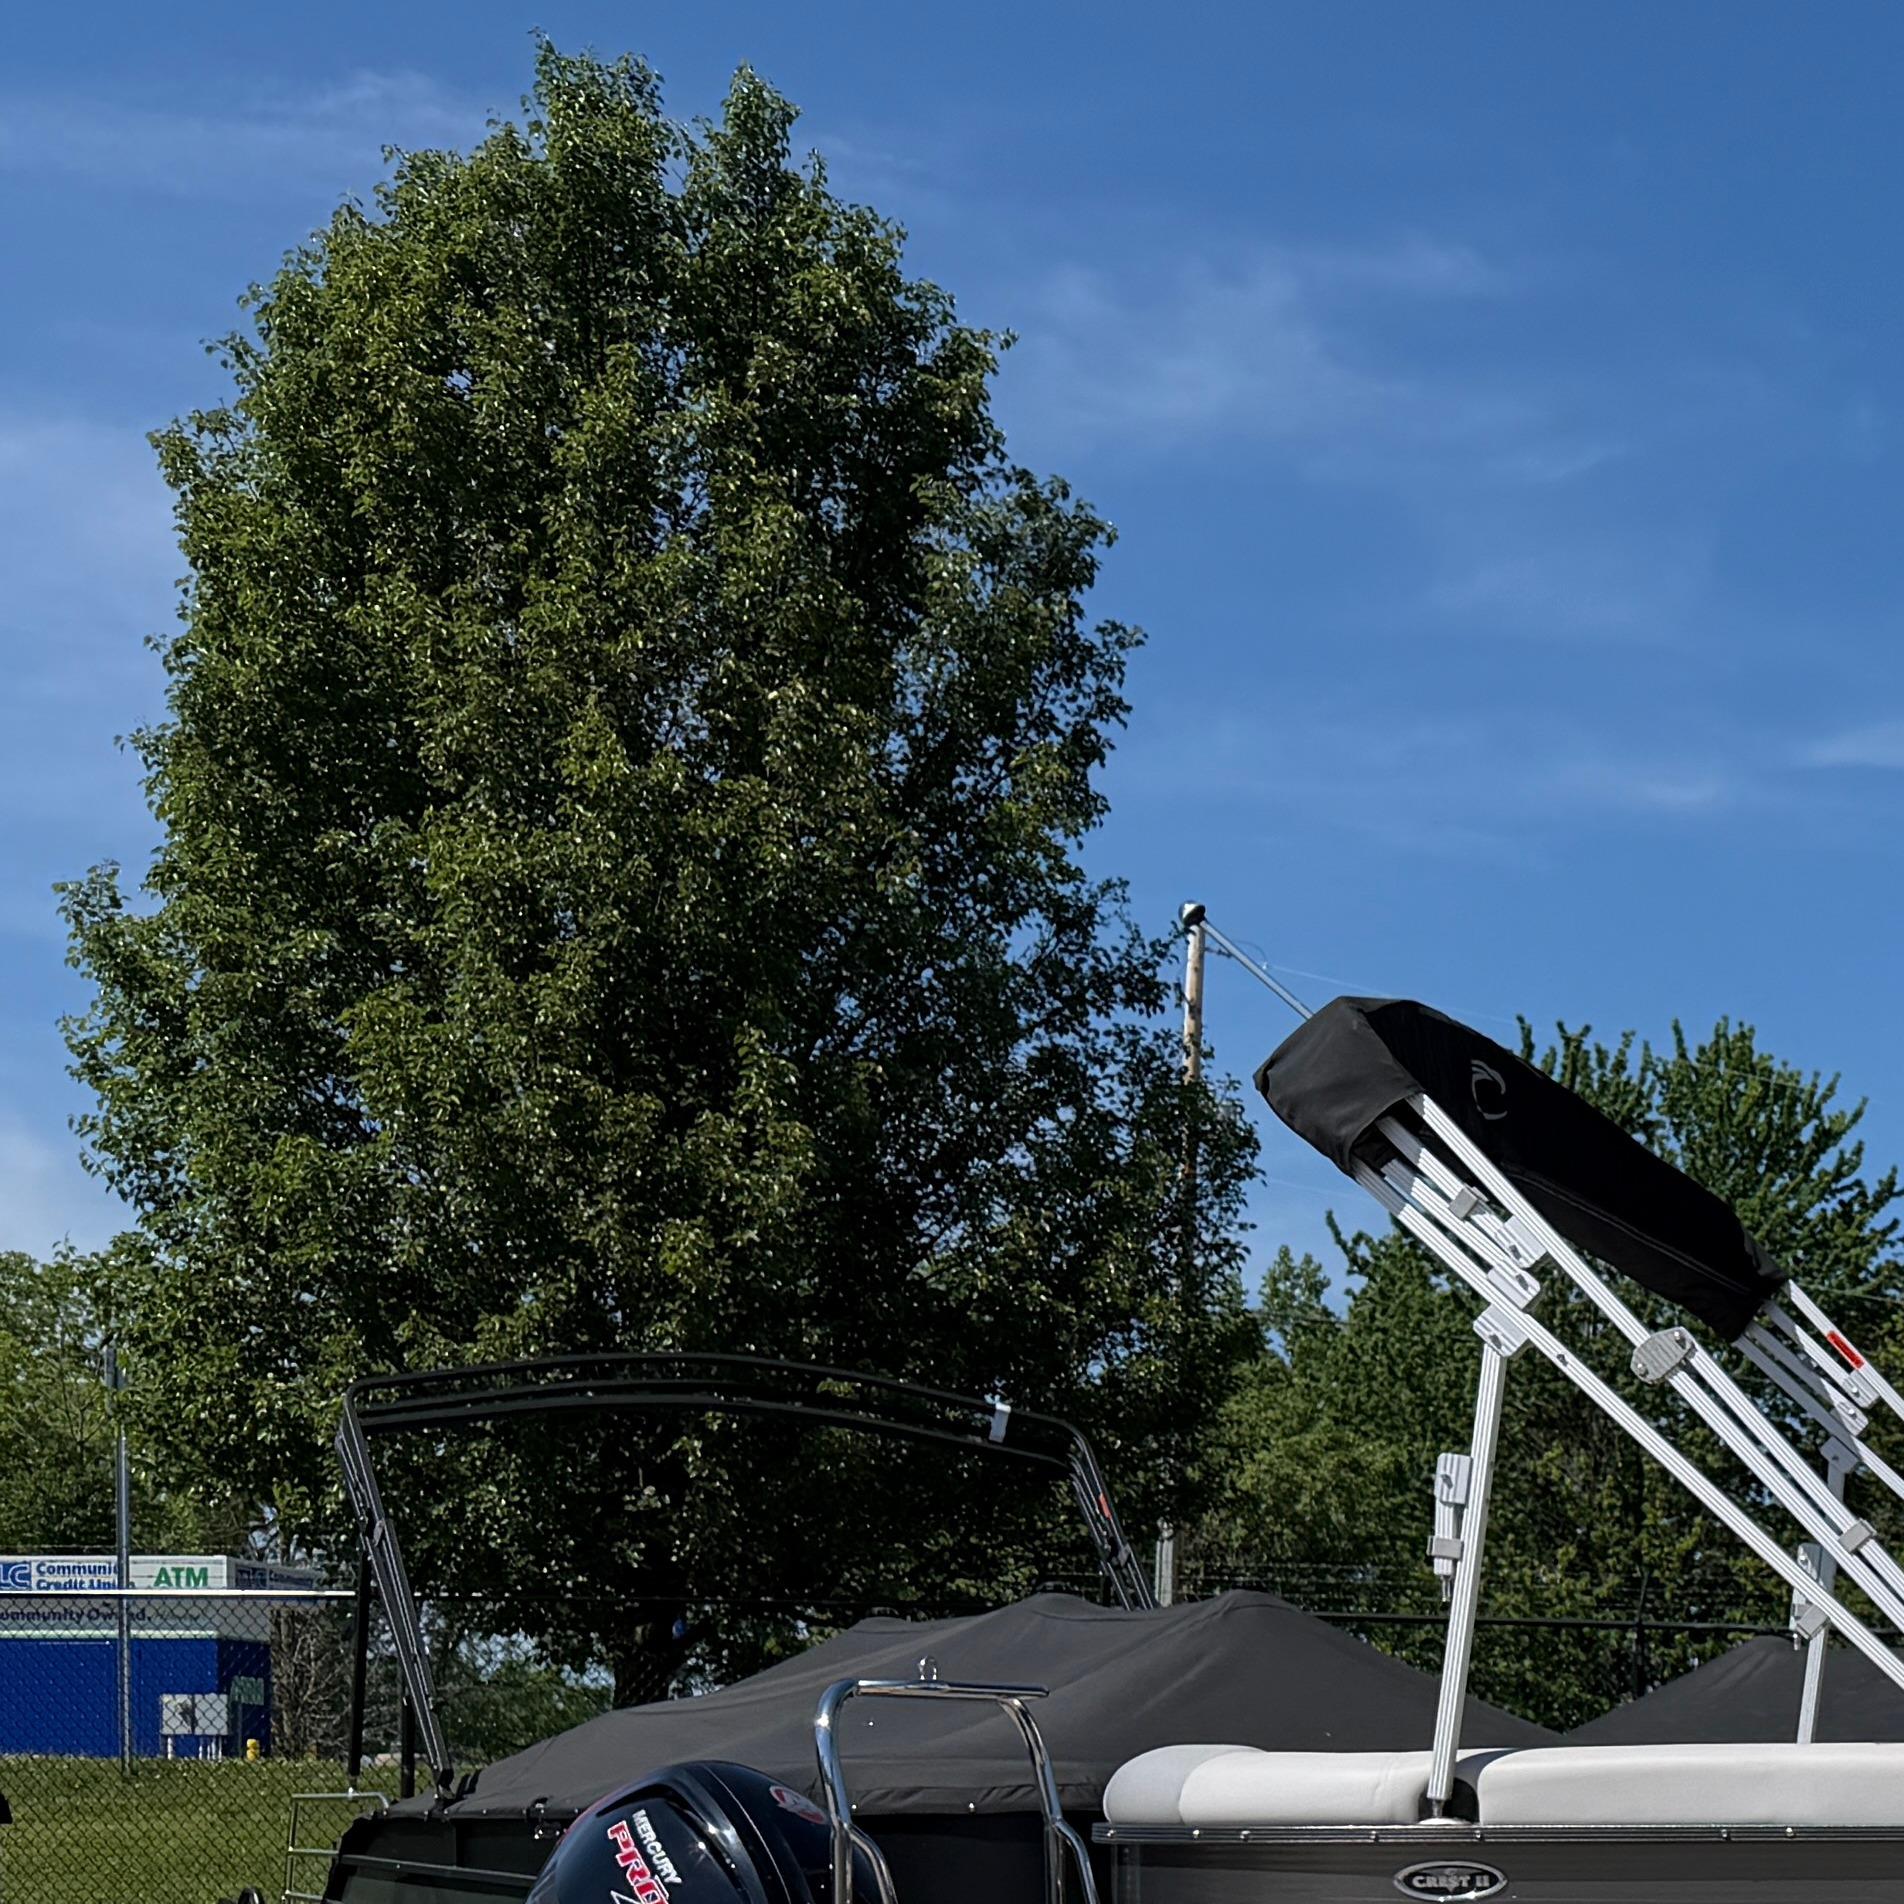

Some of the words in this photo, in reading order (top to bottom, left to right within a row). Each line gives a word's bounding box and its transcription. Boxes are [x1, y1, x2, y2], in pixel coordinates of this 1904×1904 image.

[36, 1562, 120, 1577] Communi
[154, 1567, 209, 1588] ATM
[633, 1809, 682, 1883] MERCURY
[1412, 1875, 1471, 1889] CREST
